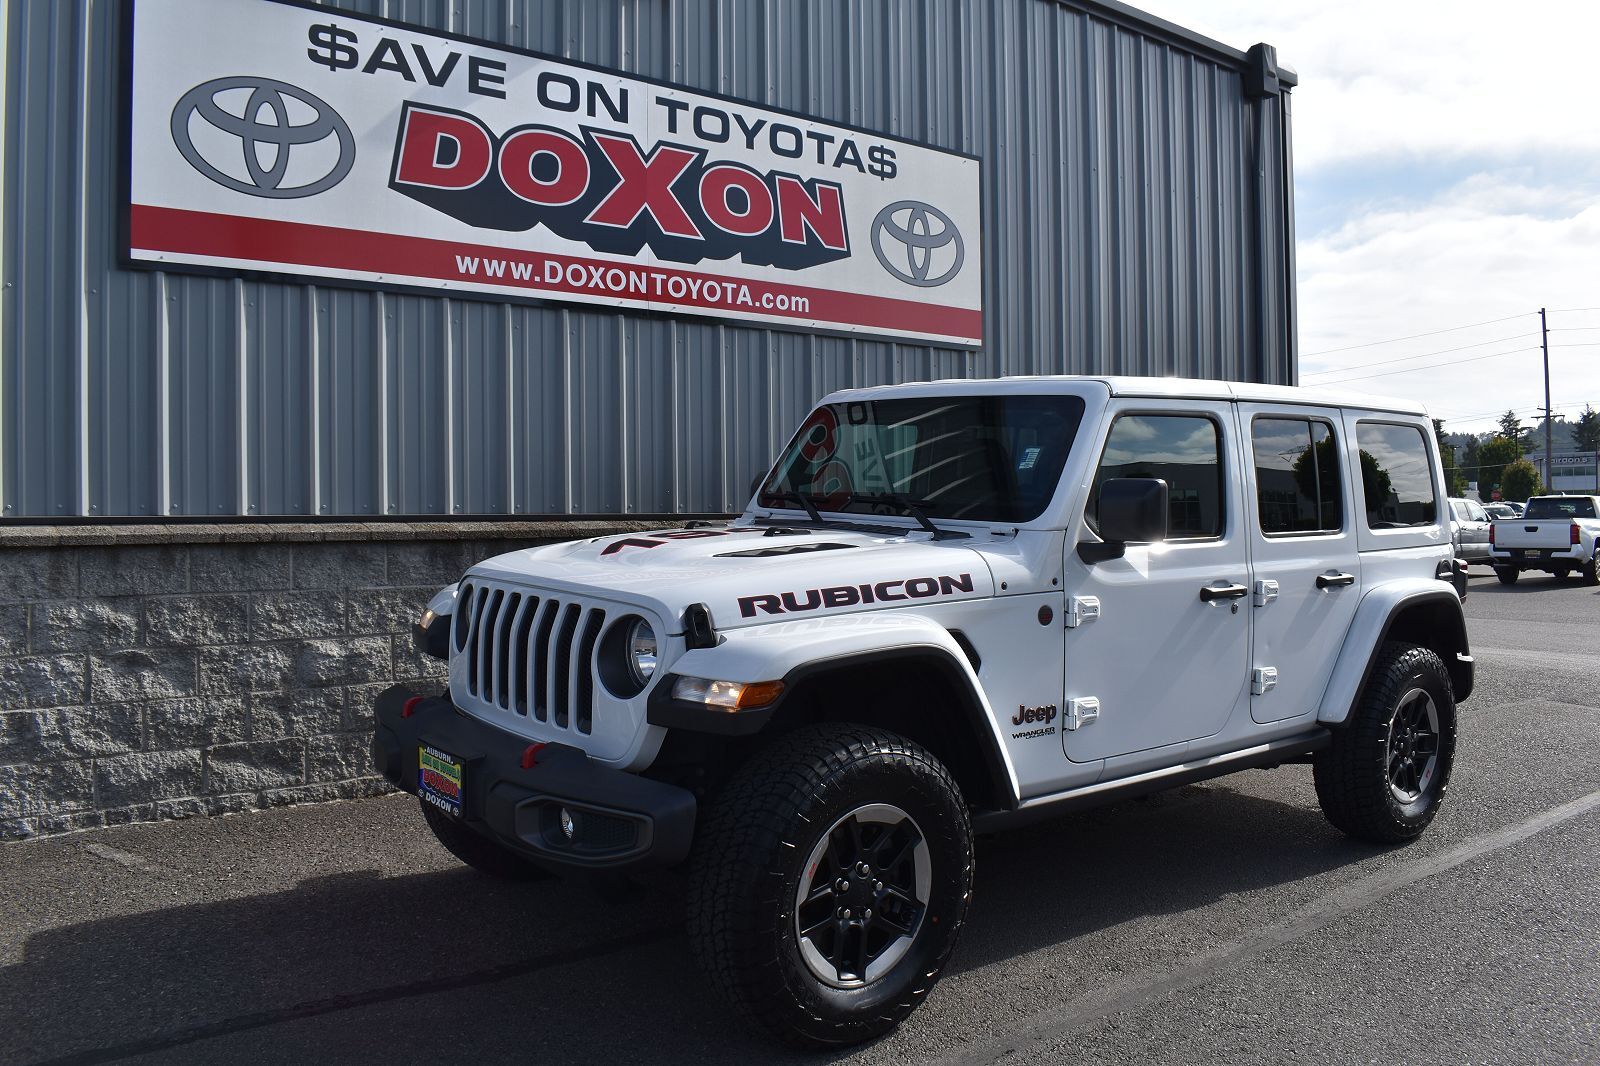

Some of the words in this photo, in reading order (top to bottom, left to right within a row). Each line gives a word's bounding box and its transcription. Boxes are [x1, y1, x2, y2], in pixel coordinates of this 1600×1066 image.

[306, 22, 508, 99] $AVE
[536, 70, 629, 124] ON
[655, 95, 898, 181] TOYOTA$
[390, 101, 851, 254] DOXON
[455, 253, 810, 314] www.DOXONTOYOTA.com
[737, 573, 974, 618] RUBICON
[1012, 703, 1057, 726] Jeep
[1012, 727, 1055, 739] WRANGLER
[425, 791, 452, 813] DOXON
